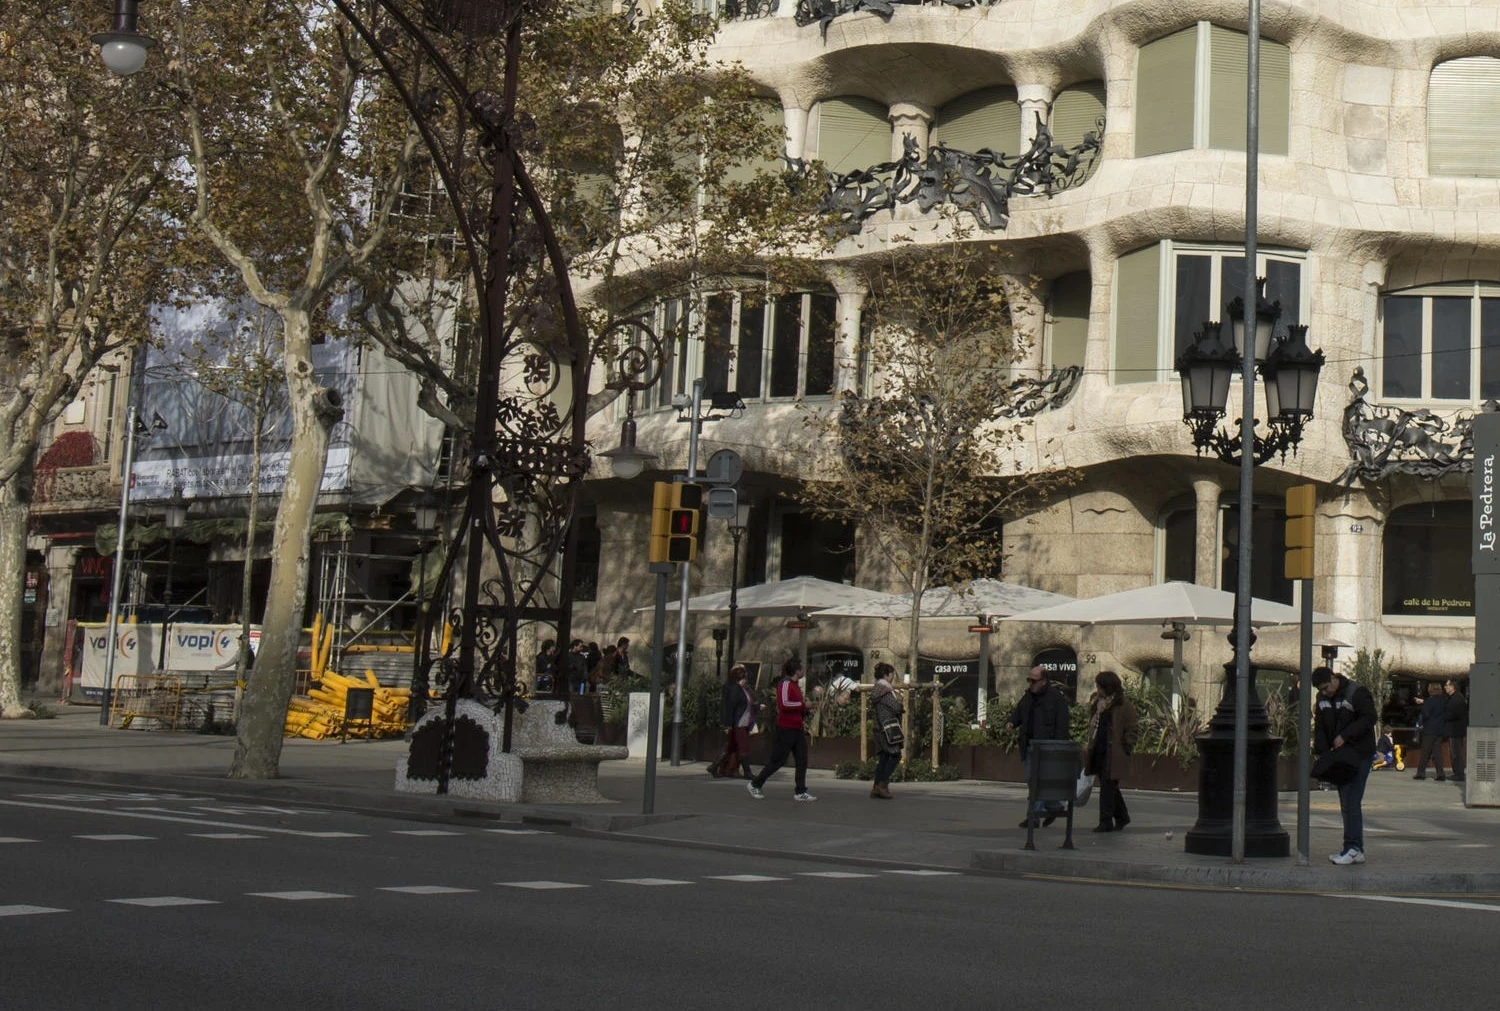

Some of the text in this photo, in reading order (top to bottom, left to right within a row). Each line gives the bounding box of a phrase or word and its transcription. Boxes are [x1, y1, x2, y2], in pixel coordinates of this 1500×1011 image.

[1479, 454, 1496, 551] La Pedrera
[1421, 598, 1431, 606] de
[1432, 598, 1440, 606] la
[1441, 598, 1471, 607] Pedrera
[90, 632, 119, 650] voi
[177, 630, 215, 650] vopi
[843, 659, 859, 667] viva
[1059, 663, 1077, 672] viva
[934, 664, 968, 673] casa viva
